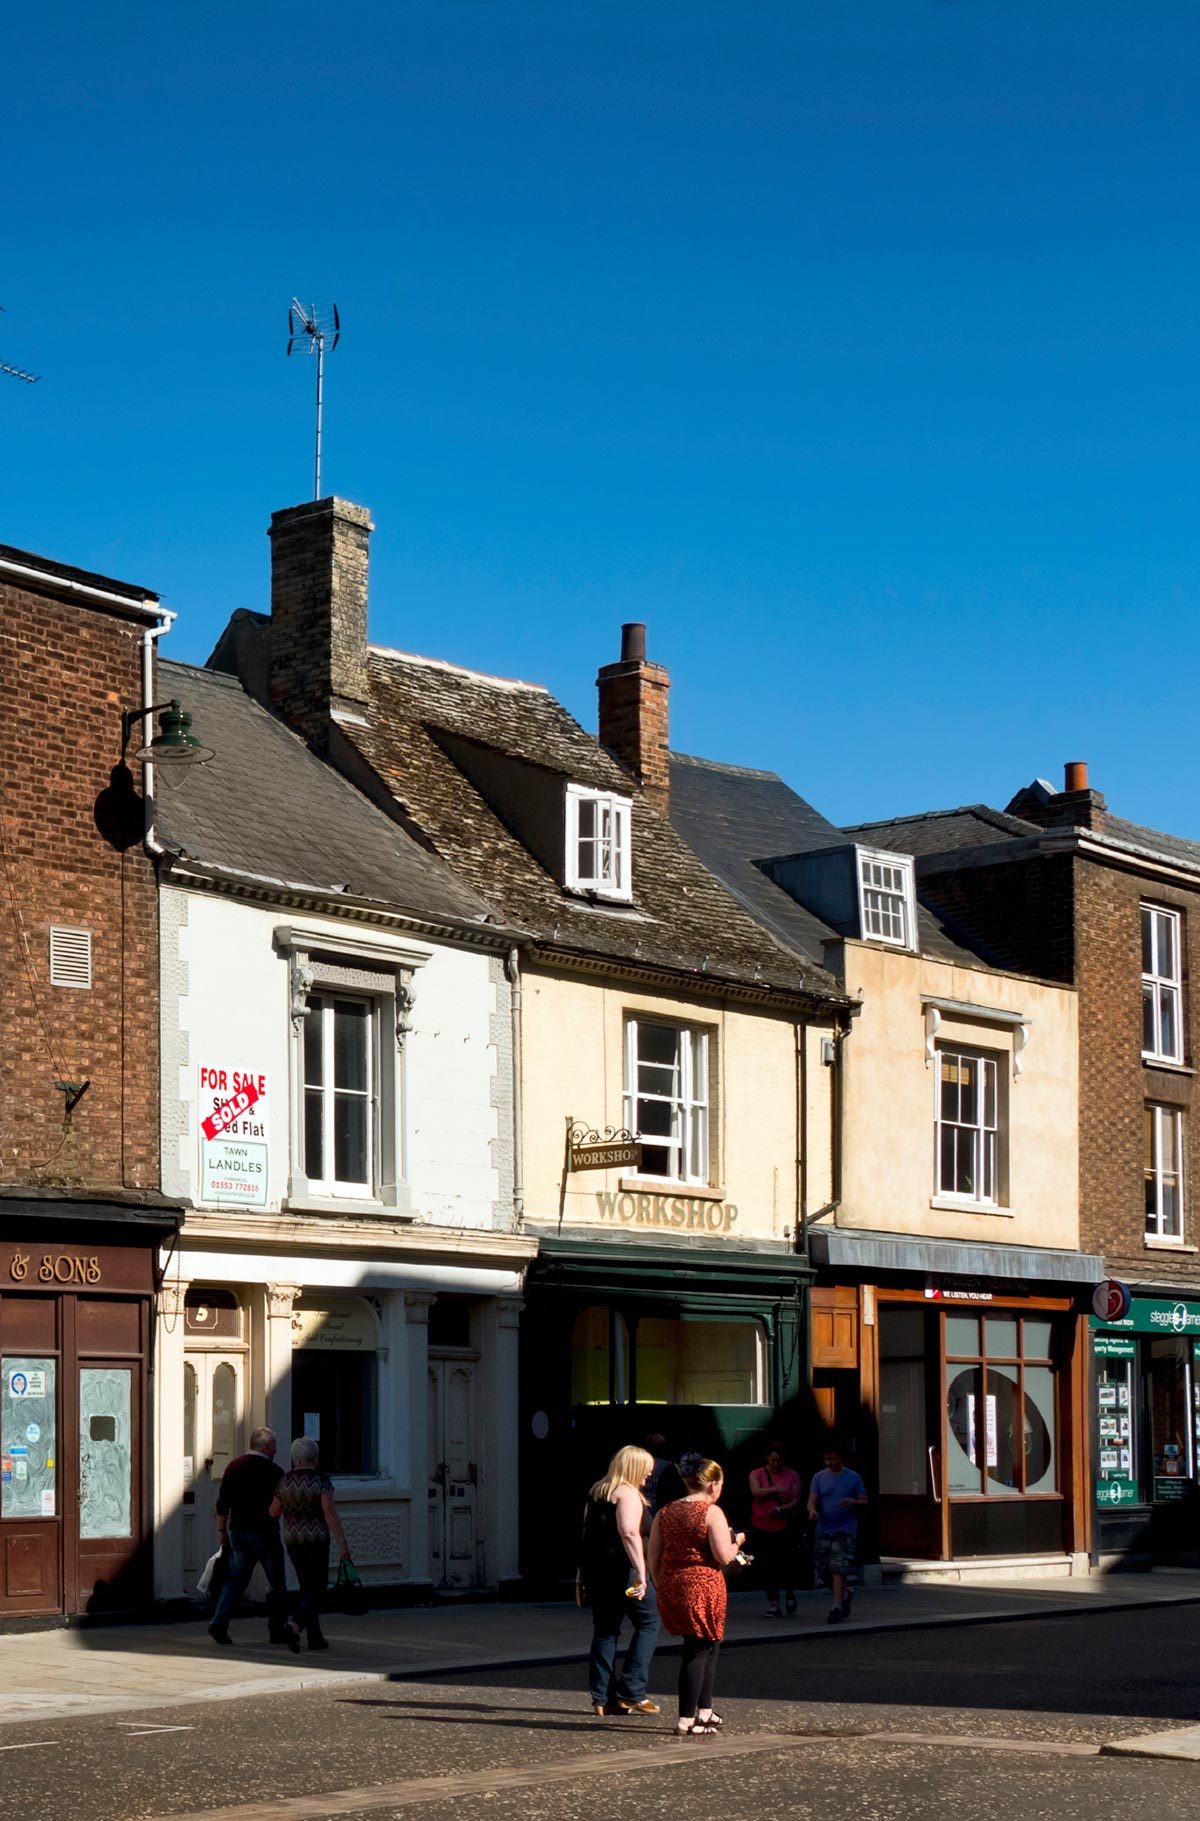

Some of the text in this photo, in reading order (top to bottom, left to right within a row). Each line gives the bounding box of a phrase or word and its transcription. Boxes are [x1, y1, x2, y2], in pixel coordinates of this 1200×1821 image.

[201, 1067, 227, 1091] FOR
[211, 1092, 249, 1131] SOLD
[242, 1121, 265, 1137] Flat
[224, 1146, 248, 1157] TAWN
[573, 1150, 638, 1166] WORKSHOP
[208, 1158, 262, 1173] LANDLES
[211, 1180, 233, 1190] 01553
[596, 1191, 738, 1233] WORKSHOP
[10, 1251, 31, 1282] &
[39, 1254, 101, 1285] SONS
[196, 1303, 208, 1322] 5
